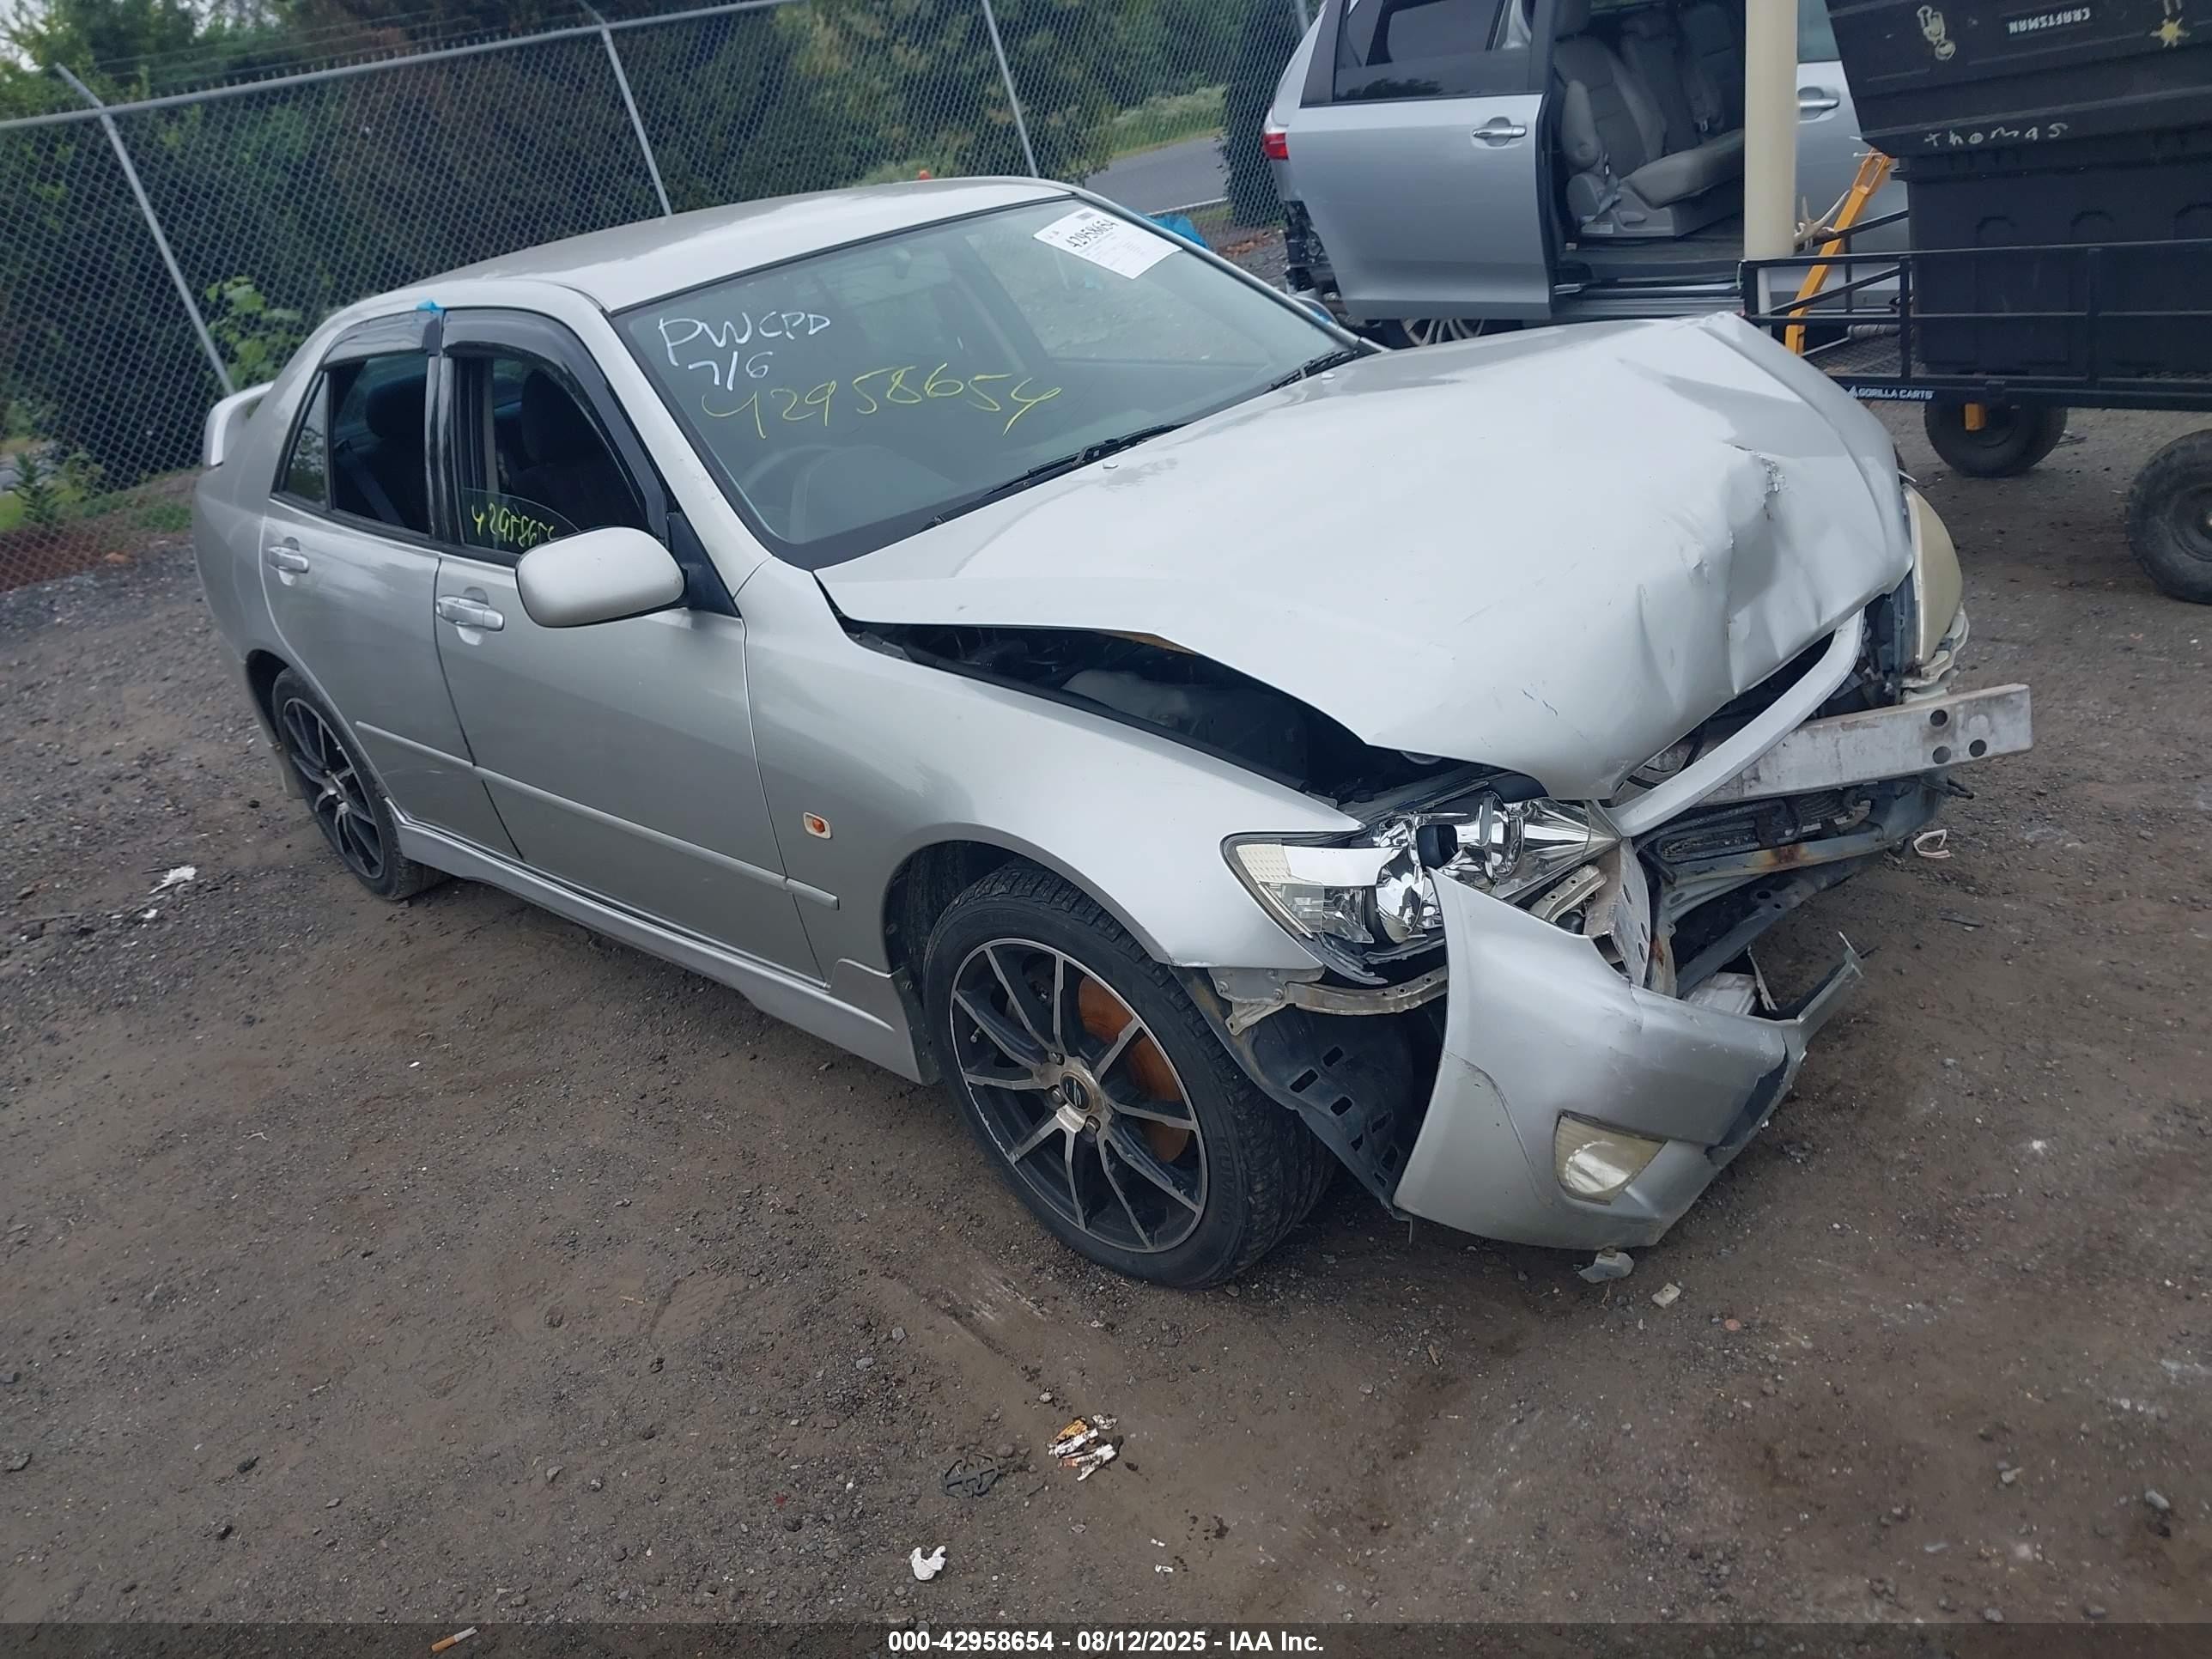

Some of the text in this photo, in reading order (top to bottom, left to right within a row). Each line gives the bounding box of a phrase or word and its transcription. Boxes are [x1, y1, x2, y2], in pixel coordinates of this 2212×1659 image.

[2008, 7, 2091, 34] CRAFTSMAN
[1065, 218, 1119, 248] 42958654
[658, 311, 831, 366] PWCPD
[701, 362, 1062, 439] 42958654
[1857, 387, 1898, 399] GORILLA
